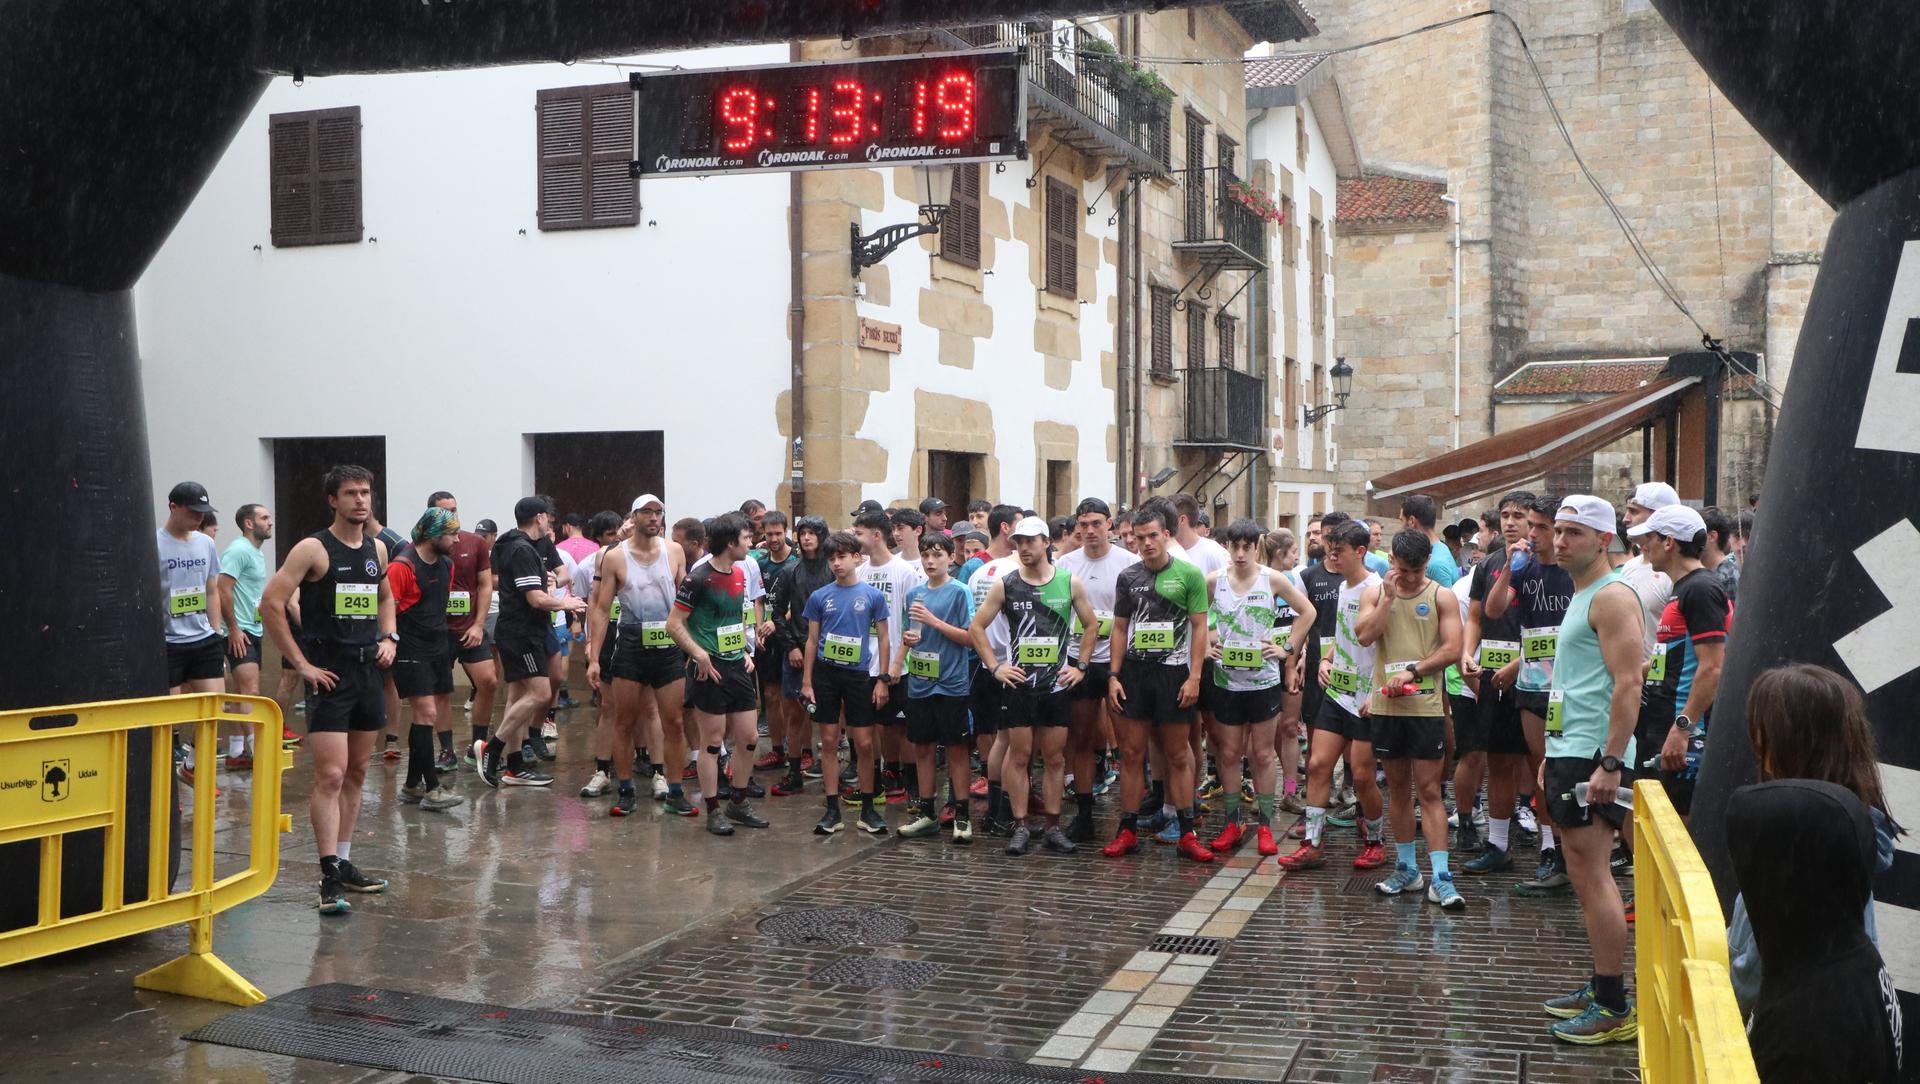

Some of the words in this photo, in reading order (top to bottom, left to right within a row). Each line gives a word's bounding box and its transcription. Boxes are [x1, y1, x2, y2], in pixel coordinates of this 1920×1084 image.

[168, 557, 206, 572] Dispes
[177, 596, 198, 608] 335
[344, 596, 370, 608] 243
[1012, 601, 1033, 610] 215
[1141, 633, 1165, 643] 242
[831, 644, 854, 657] 166
[1531, 638, 1556, 652] 261
[1026, 648, 1051, 658] 337
[1228, 651, 1254, 662] 319
[1488, 652, 1511, 663] 233
[912, 660, 931, 672] 191
[1332, 672, 1350, 686] 175
[0, 778, 38, 790] Usurbilgo
[78, 769, 98, 779] Udala
